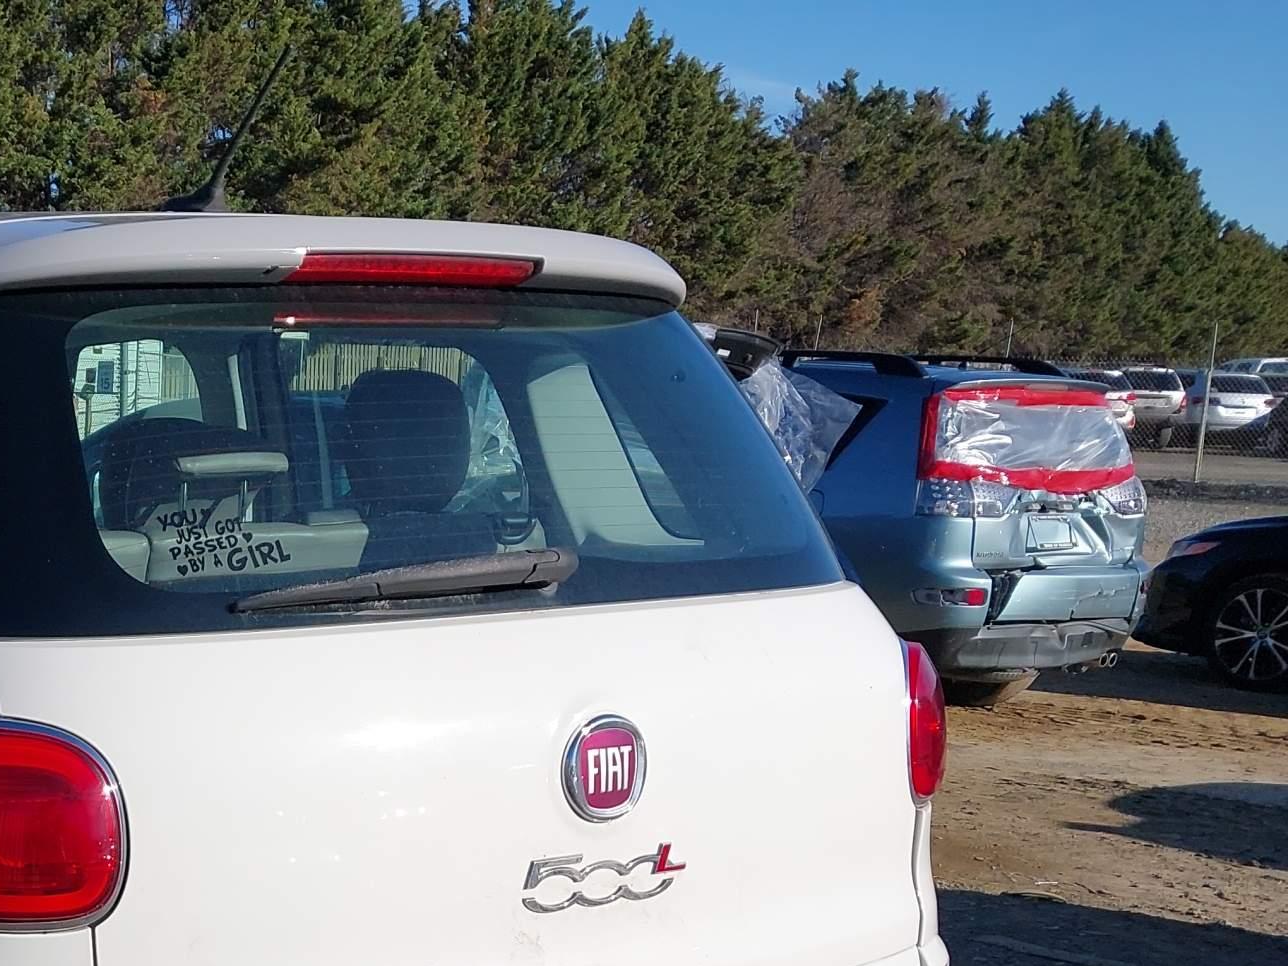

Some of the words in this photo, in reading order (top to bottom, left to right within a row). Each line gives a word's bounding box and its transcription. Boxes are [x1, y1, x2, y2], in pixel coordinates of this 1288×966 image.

[156, 508, 198, 531] YOU
[175, 524, 209, 544] JUST
[214, 516, 243, 535] GOT
[168, 534, 239, 560] PASSED
[187, 556, 205, 573] BY
[213, 553, 224, 568] A
[226, 539, 291, 572] GIRL
[587, 745, 632, 795] FIAT
